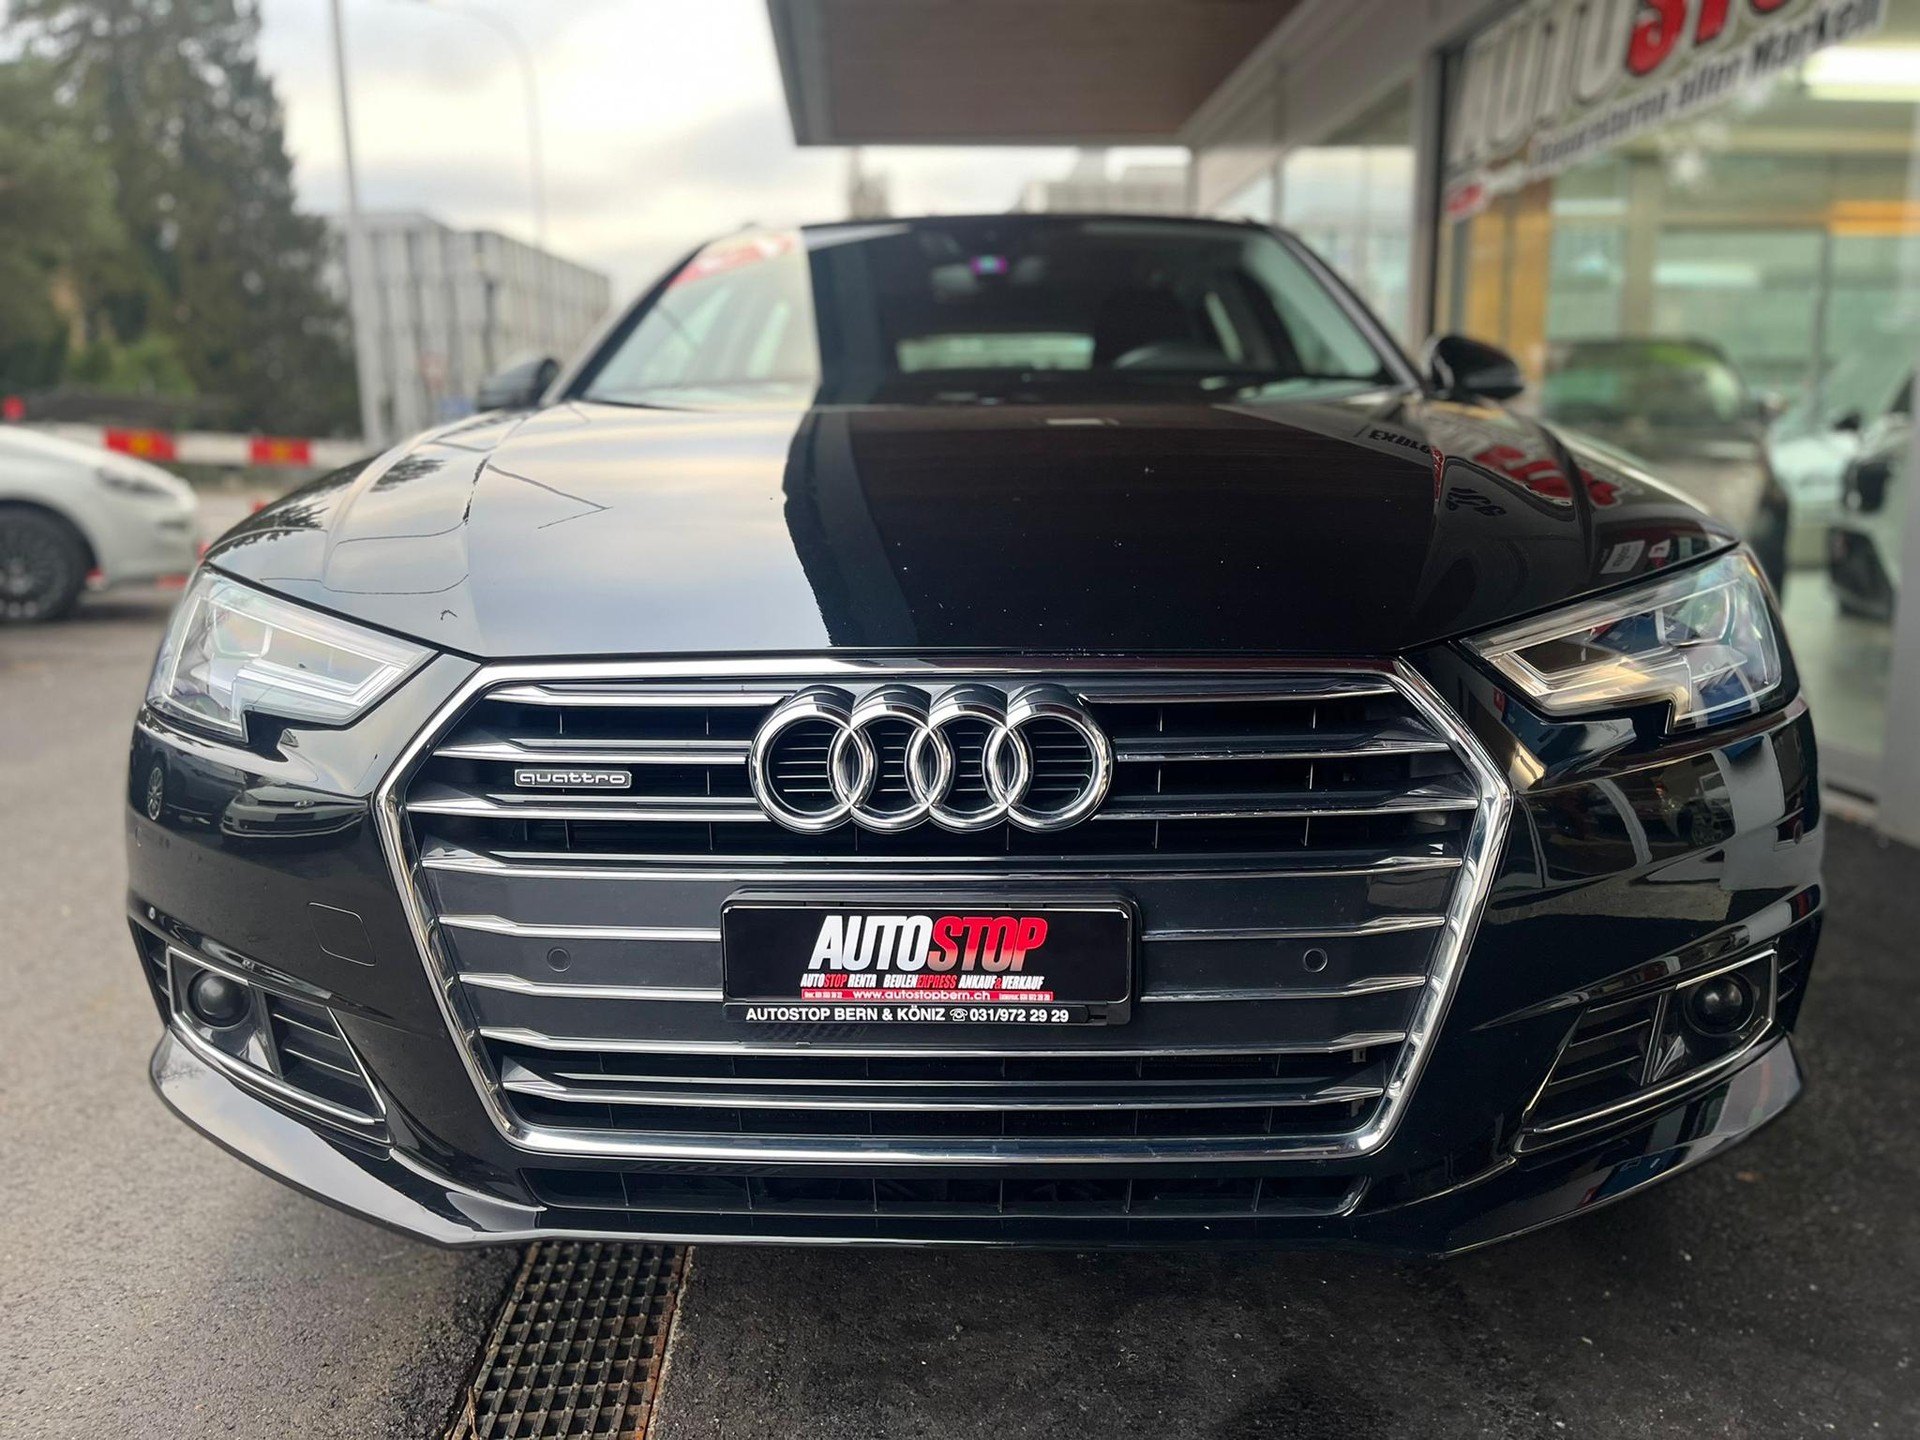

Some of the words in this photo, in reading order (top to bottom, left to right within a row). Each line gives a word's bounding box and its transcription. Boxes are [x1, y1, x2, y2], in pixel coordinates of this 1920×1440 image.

[519, 772, 627, 785] quattro
[808, 915, 1048, 972] AUTOSTOP
[800, 973, 848, 988] AUTOSTOP
[847, 974, 877, 988] RENTA
[853, 989, 991, 1001] www.autostopbern.ch
[746, 1007, 831, 1021] AUTOSTOP
[834, 1007, 878, 1021] BERN
[882, 1008, 893, 1021] &
[897, 1005, 946, 1021] KÖNIZ
[969, 1008, 1026, 1022] 031/972
[1029, 1009, 1048, 1022] 29
[1051, 1009, 1069, 1022] 29
